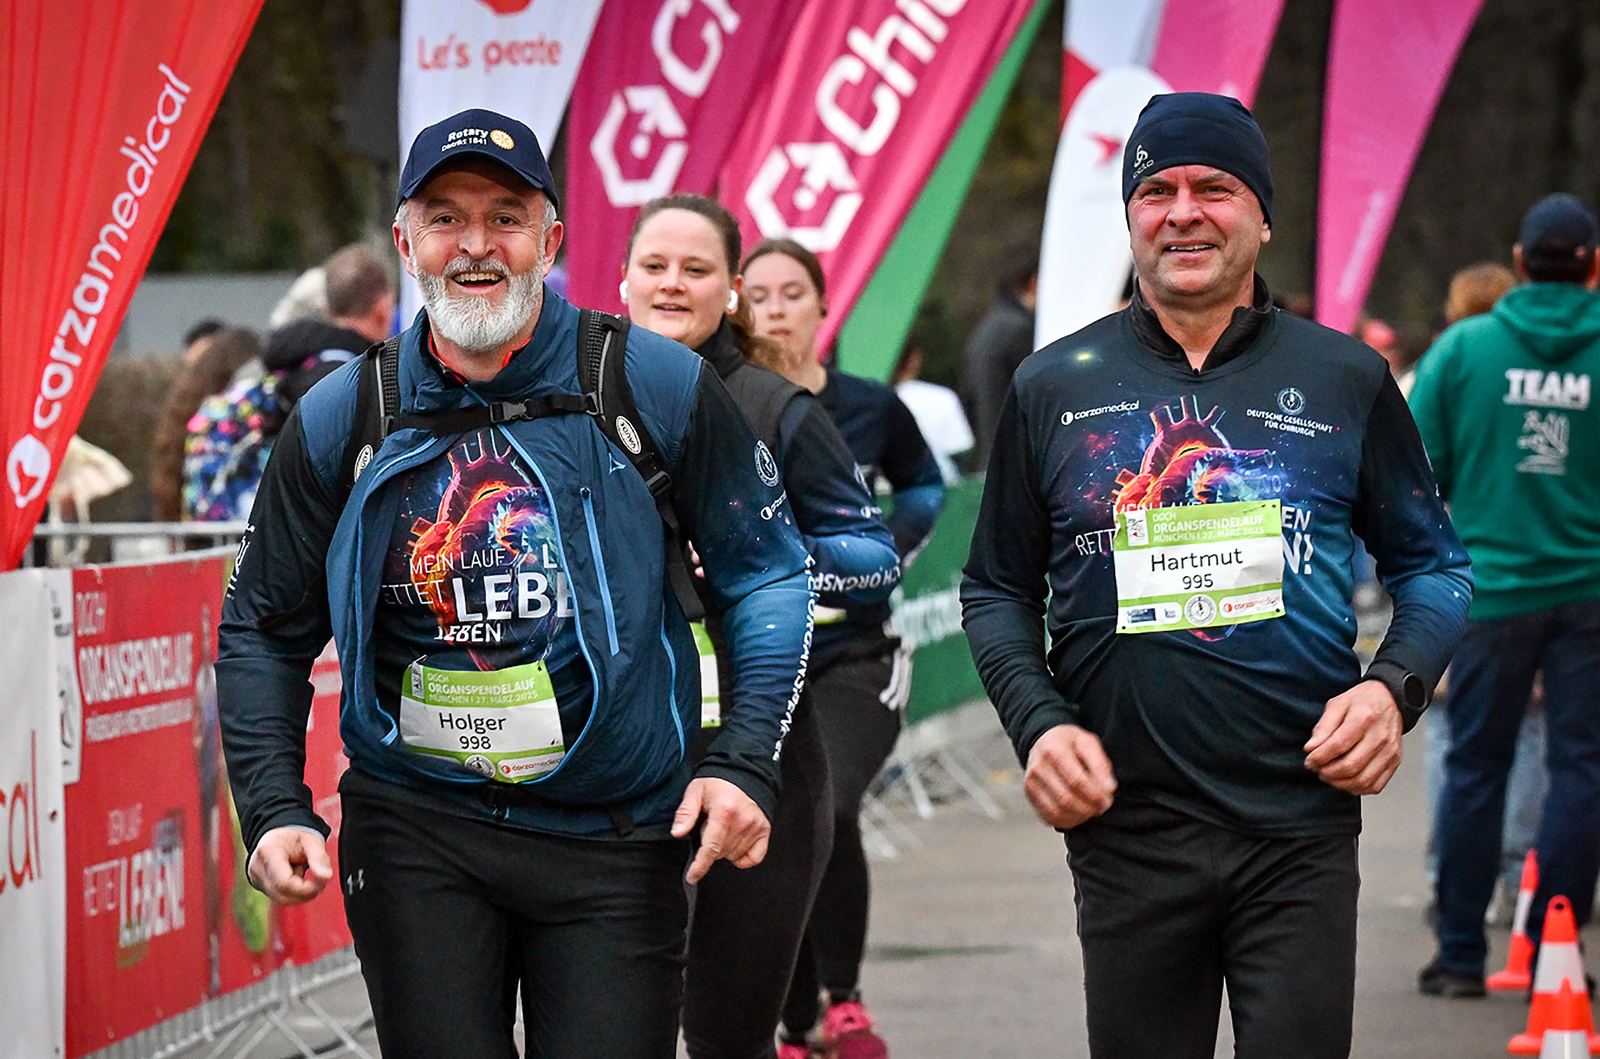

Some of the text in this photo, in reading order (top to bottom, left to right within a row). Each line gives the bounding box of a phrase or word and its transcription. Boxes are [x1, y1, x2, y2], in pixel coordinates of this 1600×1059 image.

[814, 0, 968, 156] Chi
[448, 128, 489, 142] Rotary
[469, 137, 487, 146] 1841
[33, 63, 191, 430] corzamedical
[1502, 368, 1591, 411] TEAM
[1074, 400, 1140, 420] corzamedical
[1246, 408, 1334, 434] DEUTSCHE GESELLSCHAFT
[1264, 420, 1317, 438] FÜR CHIRURGIE
[1152, 512, 1177, 522] DGCH
[1153, 514, 1265, 534] ORGANSPENDELAUF
[1282, 505, 1312, 531] EN
[1153, 531, 1195, 543] MÜNCHEN
[1201, 531, 1216, 540] 27.
[1217, 528, 1242, 538] MÄRZ
[409, 543, 562, 575] MEIN LAUF L
[1075, 528, 1116, 556] RETT
[1281, 531, 1314, 575] N!
[1151, 548, 1243, 572] Hartmut
[1182, 573, 1214, 590] 995
[381, 571, 576, 622] ETTET LEBE
[428, 677, 535, 695] ORGANSPENDELAUF
[439, 712, 507, 735] Holger
[459, 735, 492, 750] 998
